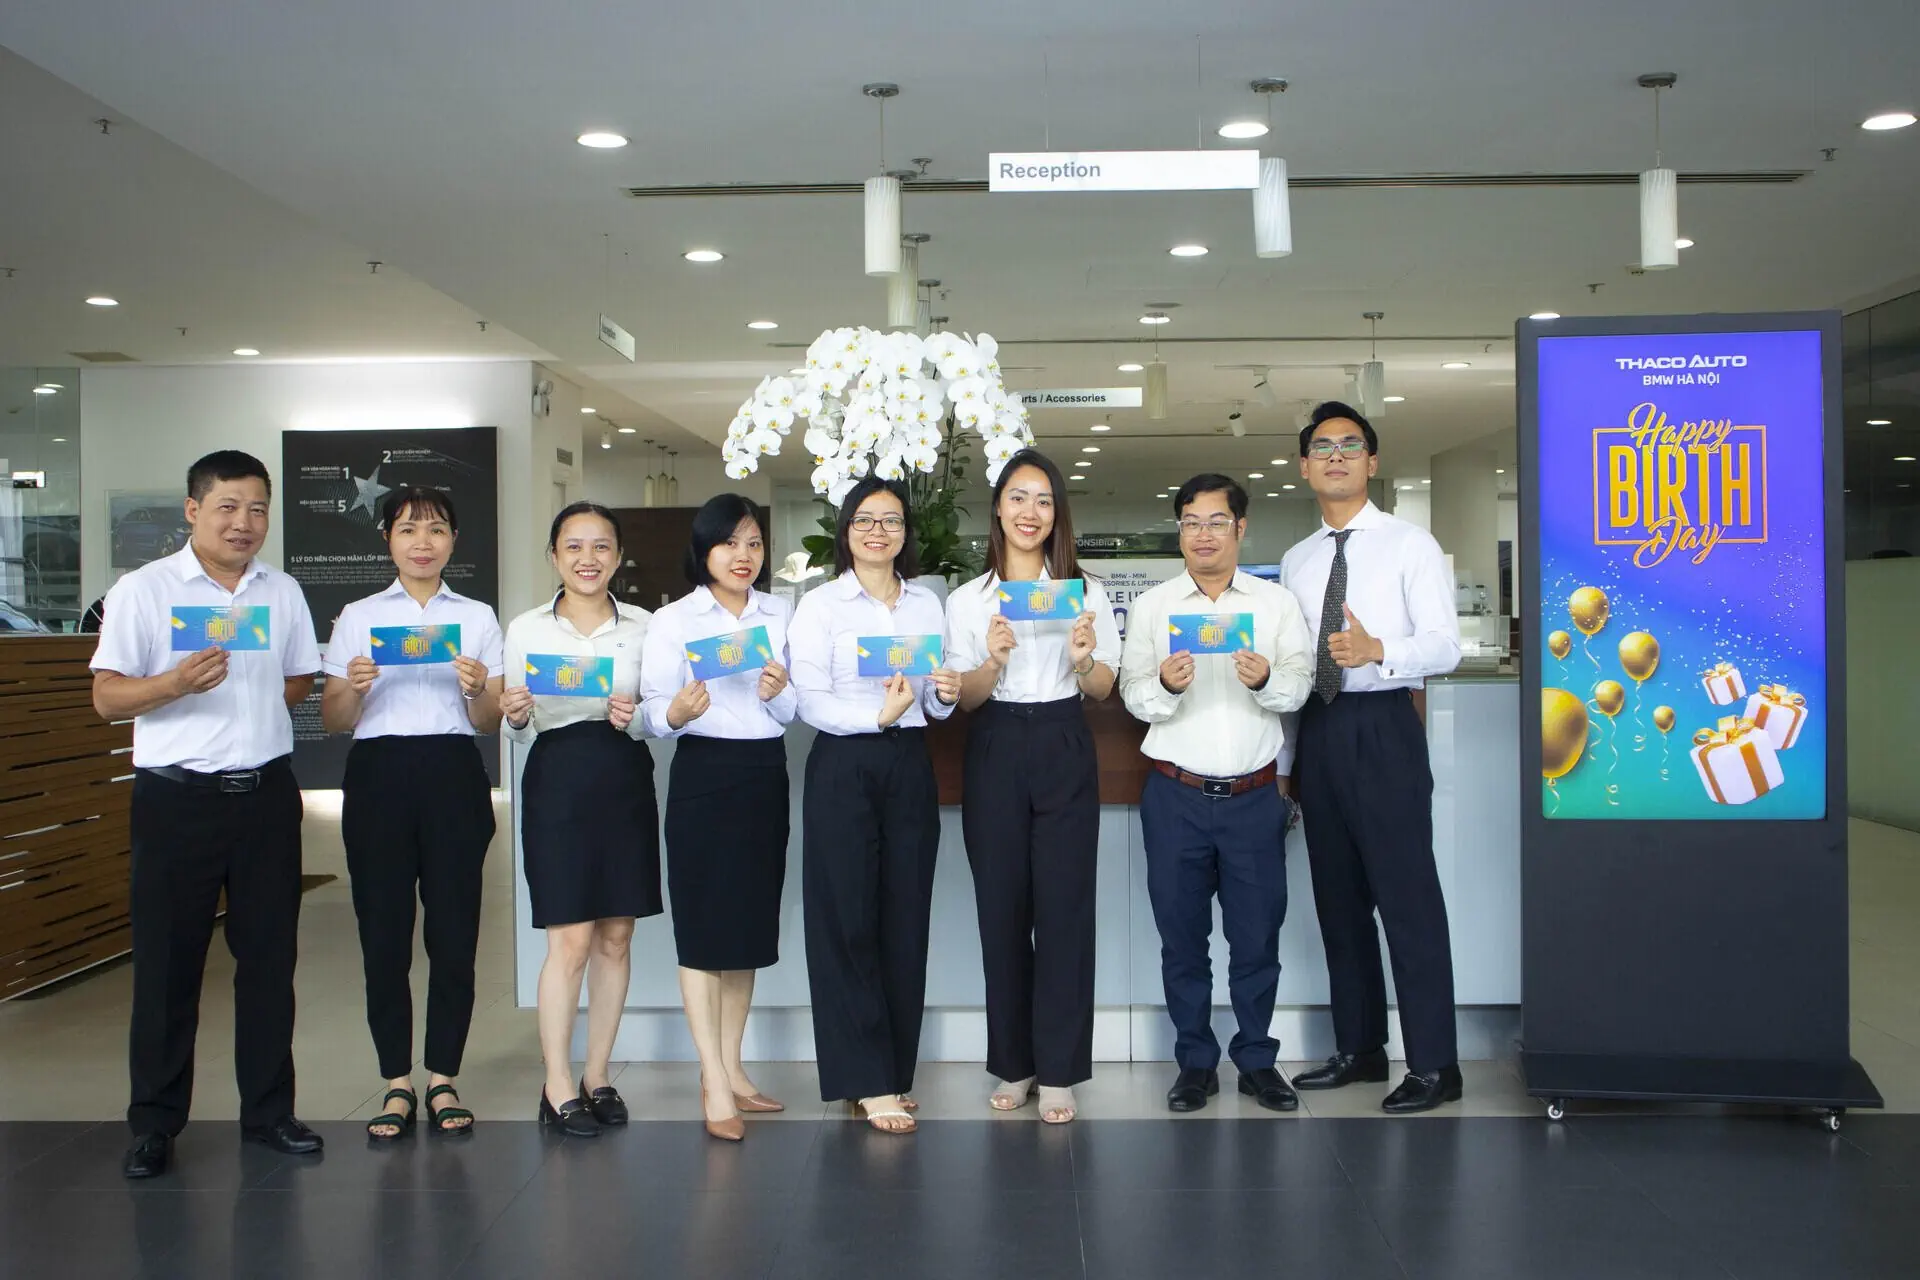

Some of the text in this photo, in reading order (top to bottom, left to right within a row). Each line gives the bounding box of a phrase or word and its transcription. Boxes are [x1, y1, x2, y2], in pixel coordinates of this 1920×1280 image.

[1000, 162, 1101, 182] Reception
[1615, 354, 1748, 370] THACO AUTO
[1643, 371, 1720, 386] BMW HÀ NỘI
[1045, 393, 1106, 403] Accessories
[1628, 402, 1733, 458] Happy
[382, 450, 392, 463] 2
[342, 466, 349, 480] 1
[1609, 443, 1751, 528] BIRTH
[338, 499, 346, 513] 5
[1633, 515, 1726, 569] Day
[1106, 591, 1125, 603] LE
